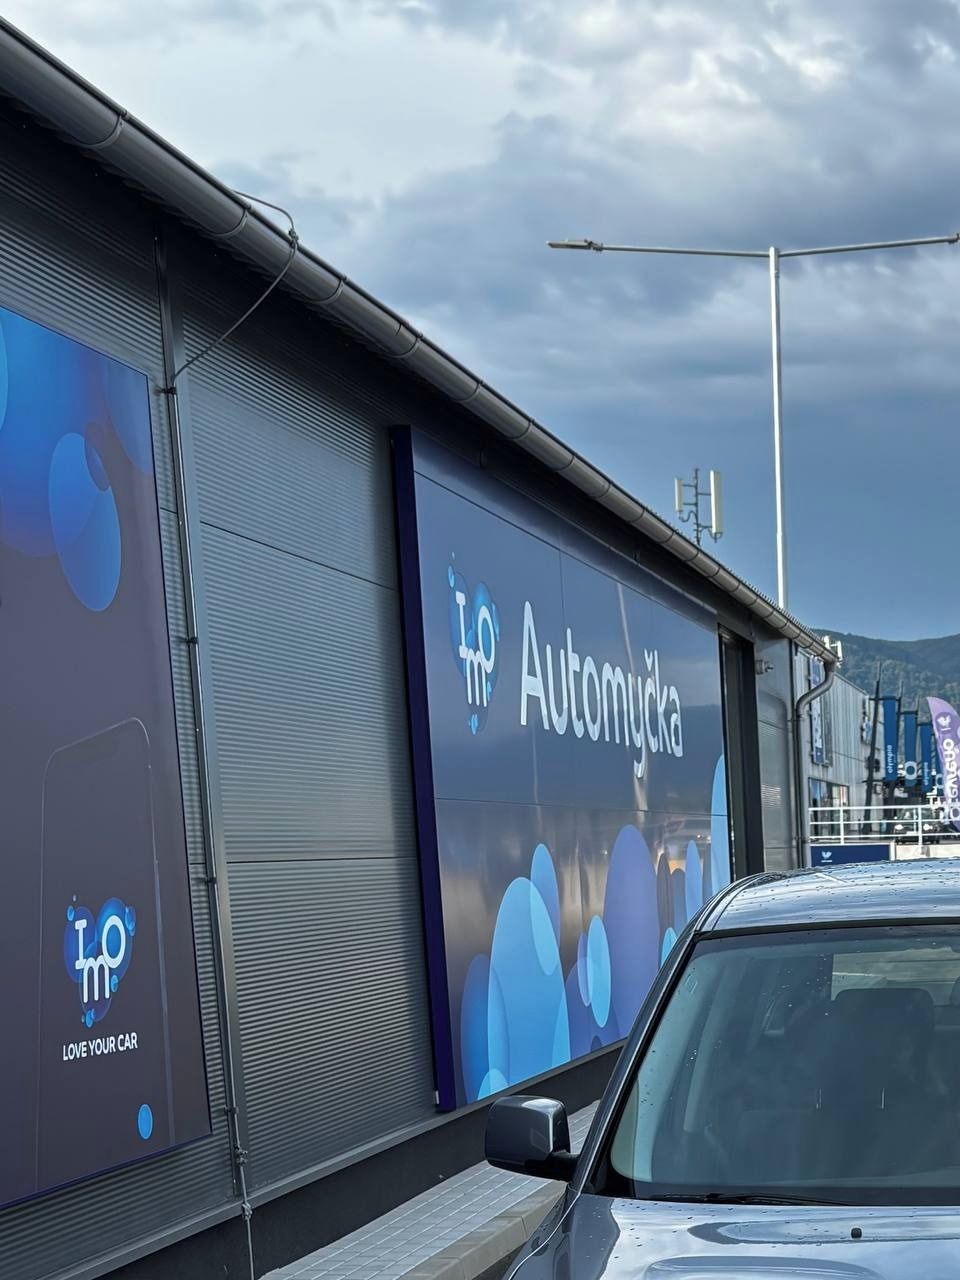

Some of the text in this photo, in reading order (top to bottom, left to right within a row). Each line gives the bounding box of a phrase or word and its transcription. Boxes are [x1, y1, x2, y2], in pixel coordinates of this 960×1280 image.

[520, 600, 684, 778] Automyčka
[63, 1032, 138, 1061] LOVE YOUR CAR
